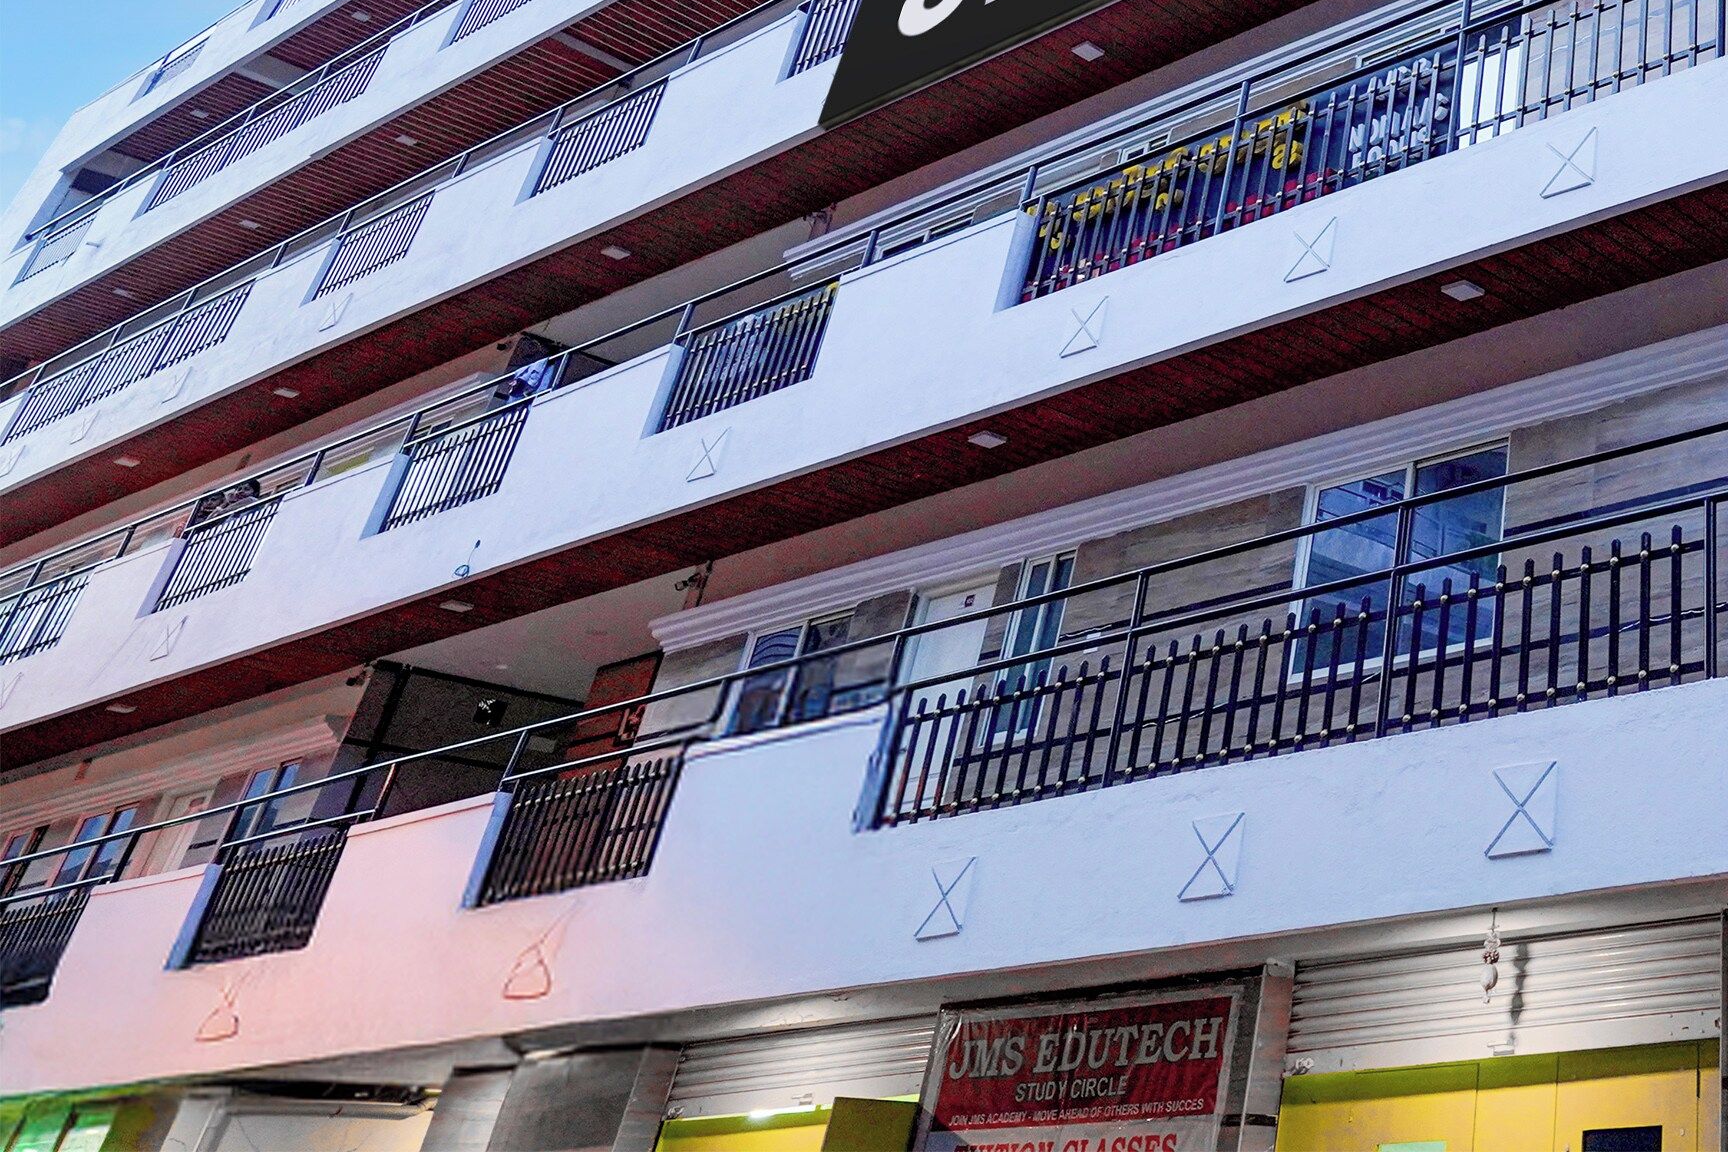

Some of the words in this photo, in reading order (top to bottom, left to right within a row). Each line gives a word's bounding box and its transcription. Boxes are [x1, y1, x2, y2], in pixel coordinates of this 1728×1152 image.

[949, 1036, 1026, 1079] JMS
[1033, 1017, 1223, 1073] EDUTECH
[1015, 1079, 1067, 1102] STUDY
[1070, 1075, 1127, 1098] CIRCLE
[986, 1111, 1027, 1123] ACADEMY
[1033, 1109, 1058, 1121] MOVE
[1104, 1103, 1140, 1116] OTHERS
